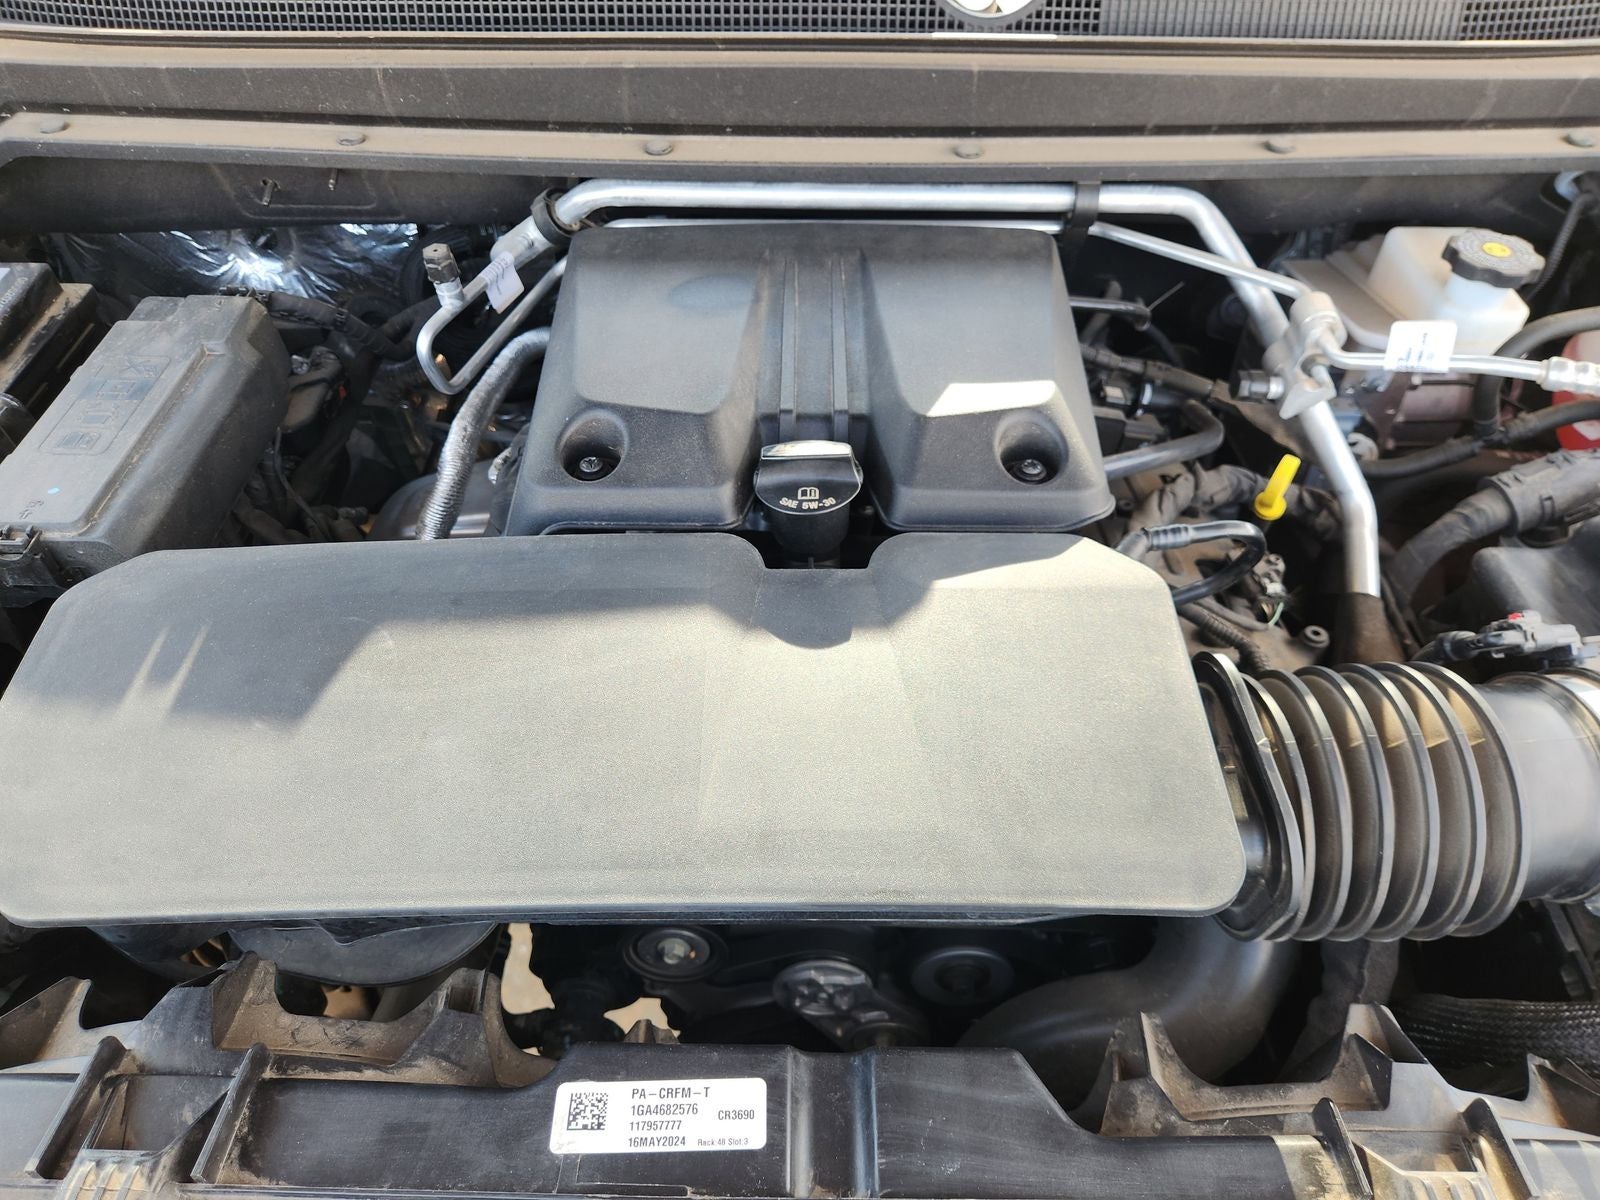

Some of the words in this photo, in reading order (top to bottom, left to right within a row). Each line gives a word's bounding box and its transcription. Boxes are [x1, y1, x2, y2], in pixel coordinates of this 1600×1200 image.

[779, 497, 798, 509] SAE
[801, 497, 837, 510] 5W-30
[631, 1103, 698, 1116] 1GA4682576
[717, 1109, 755, 1120] CR3690
[629, 1120, 682, 1131] 117957777
[628, 1136, 686, 1147] 16MAY2024
